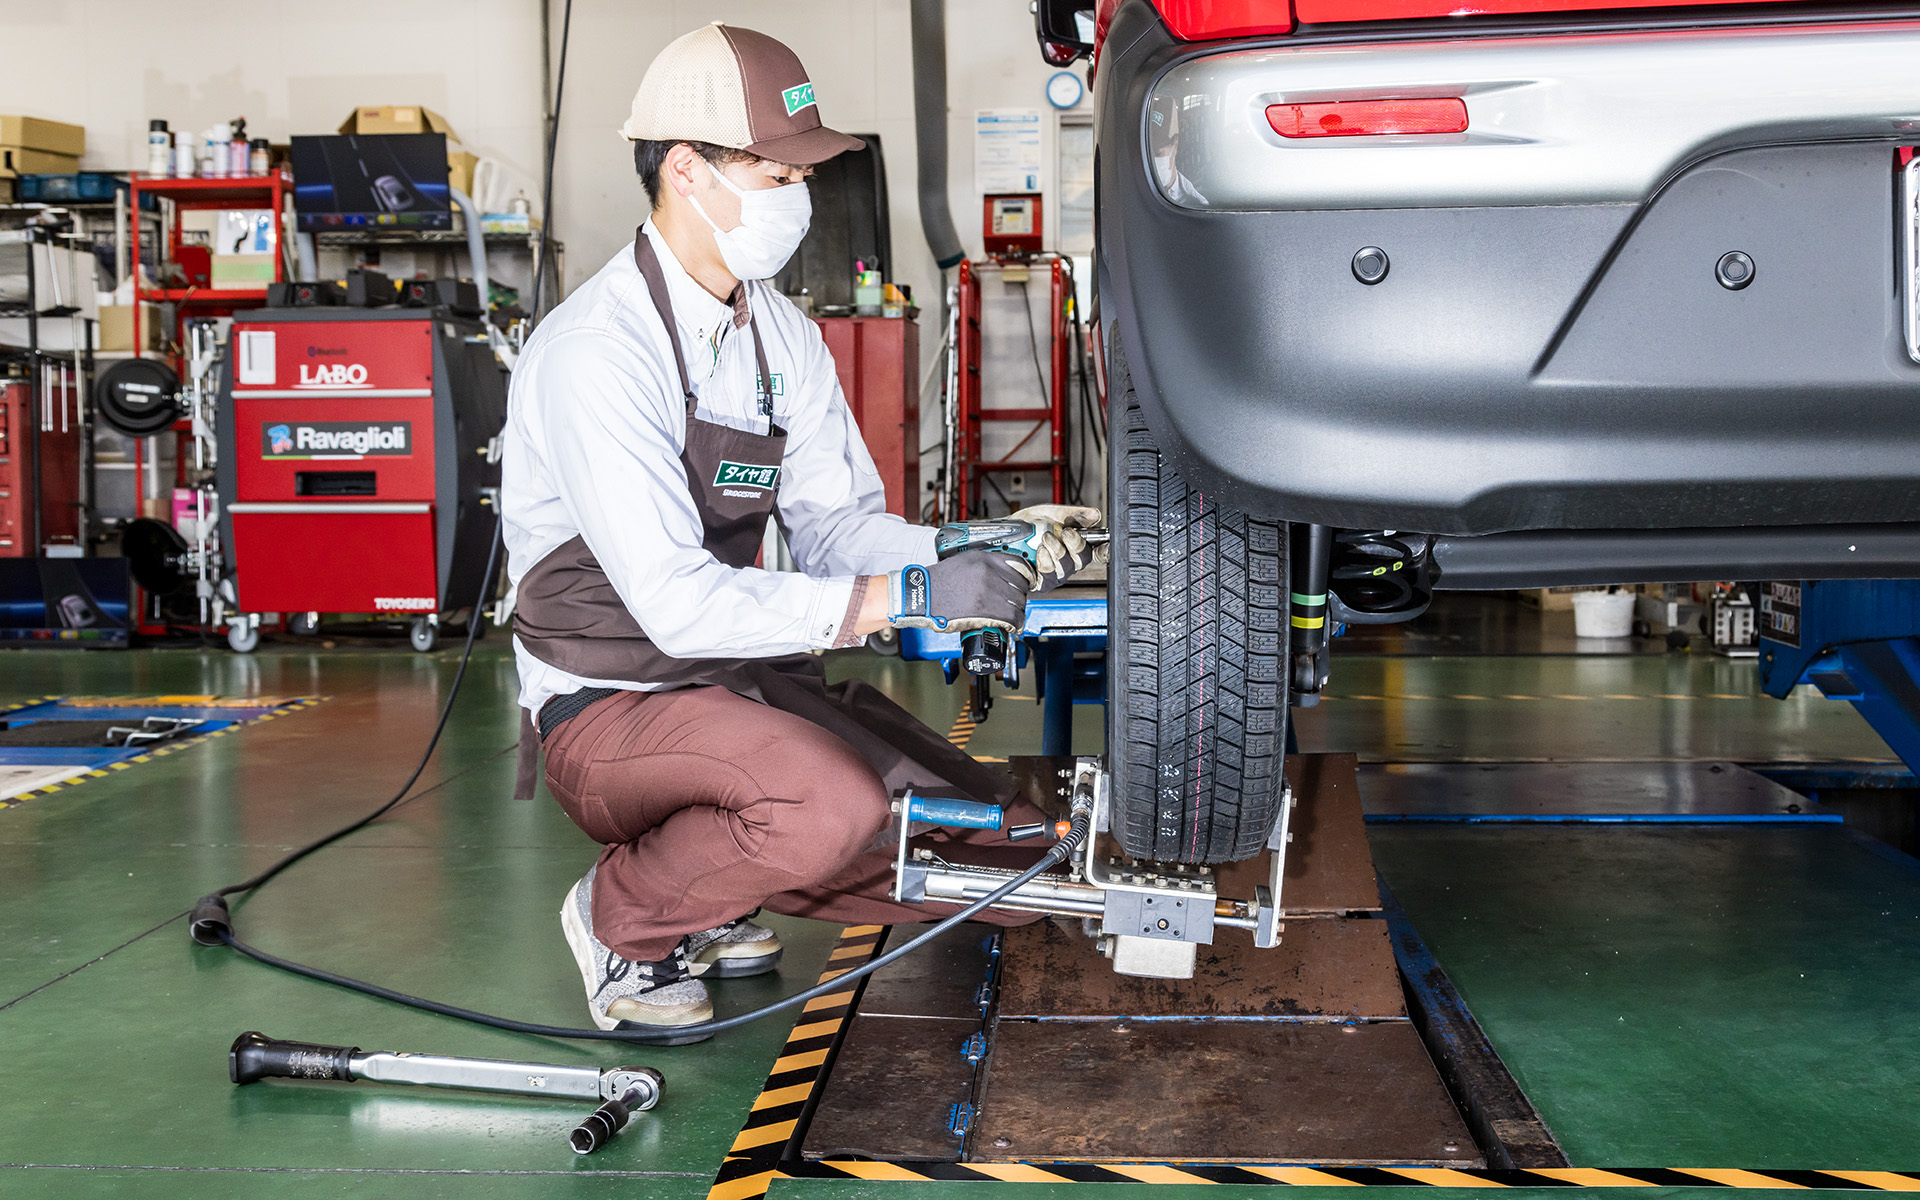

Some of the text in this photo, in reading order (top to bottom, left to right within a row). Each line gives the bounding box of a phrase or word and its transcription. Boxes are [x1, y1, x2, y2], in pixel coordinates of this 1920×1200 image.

[299, 363, 368, 385] LABO
[296, 426, 406, 454] Ravaglioli
[725, 466, 773, 483] タイヤ館
